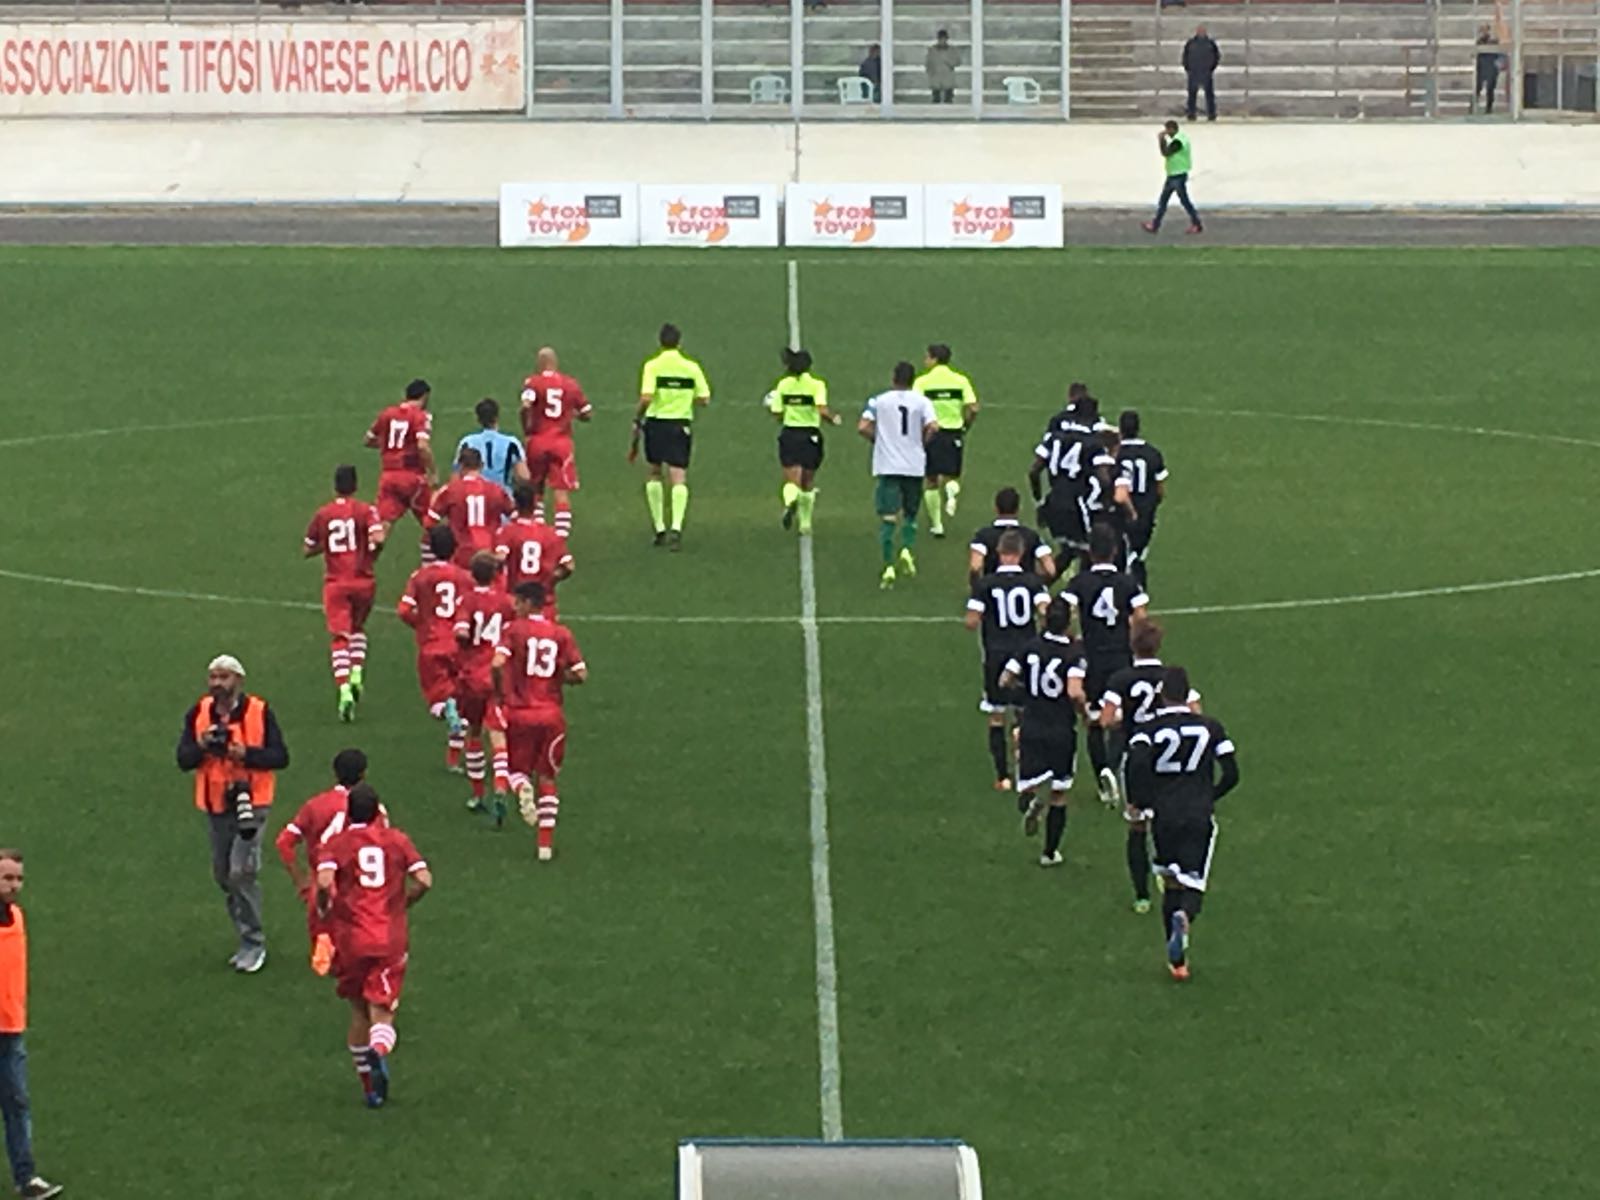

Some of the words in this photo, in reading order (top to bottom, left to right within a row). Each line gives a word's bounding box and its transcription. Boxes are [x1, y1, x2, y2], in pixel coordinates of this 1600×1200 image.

[0, 40, 168, 95] SSOCIAZIONE
[179, 40, 261, 94] TIFOSI
[269, 40, 369, 94] VARESE
[377, 39, 471, 94] CALCIO
[550, 206, 590, 218] FOX
[689, 206, 728, 218] FOX
[836, 206, 876, 219] FOX
[974, 206, 1014, 219] FOX
[545, 387, 564, 419] 5
[899, 405, 909, 436] 1
[388, 418, 410, 449] 17
[486, 441, 493, 470] 1
[1049, 439, 1083, 479] 14
[466, 495, 486, 527] 11
[327, 518, 357, 553] 21
[520, 540, 542, 575] 8
[435, 581, 456, 619] 3
[991, 586, 1031, 628] 10
[1092, 586, 1119, 626] 4
[473, 610, 503, 647] 14
[526, 636, 559, 678] 13
[1026, 653, 1065, 698] 16
[1154, 725, 1211, 774] 27
[358, 846, 386, 888] 9
